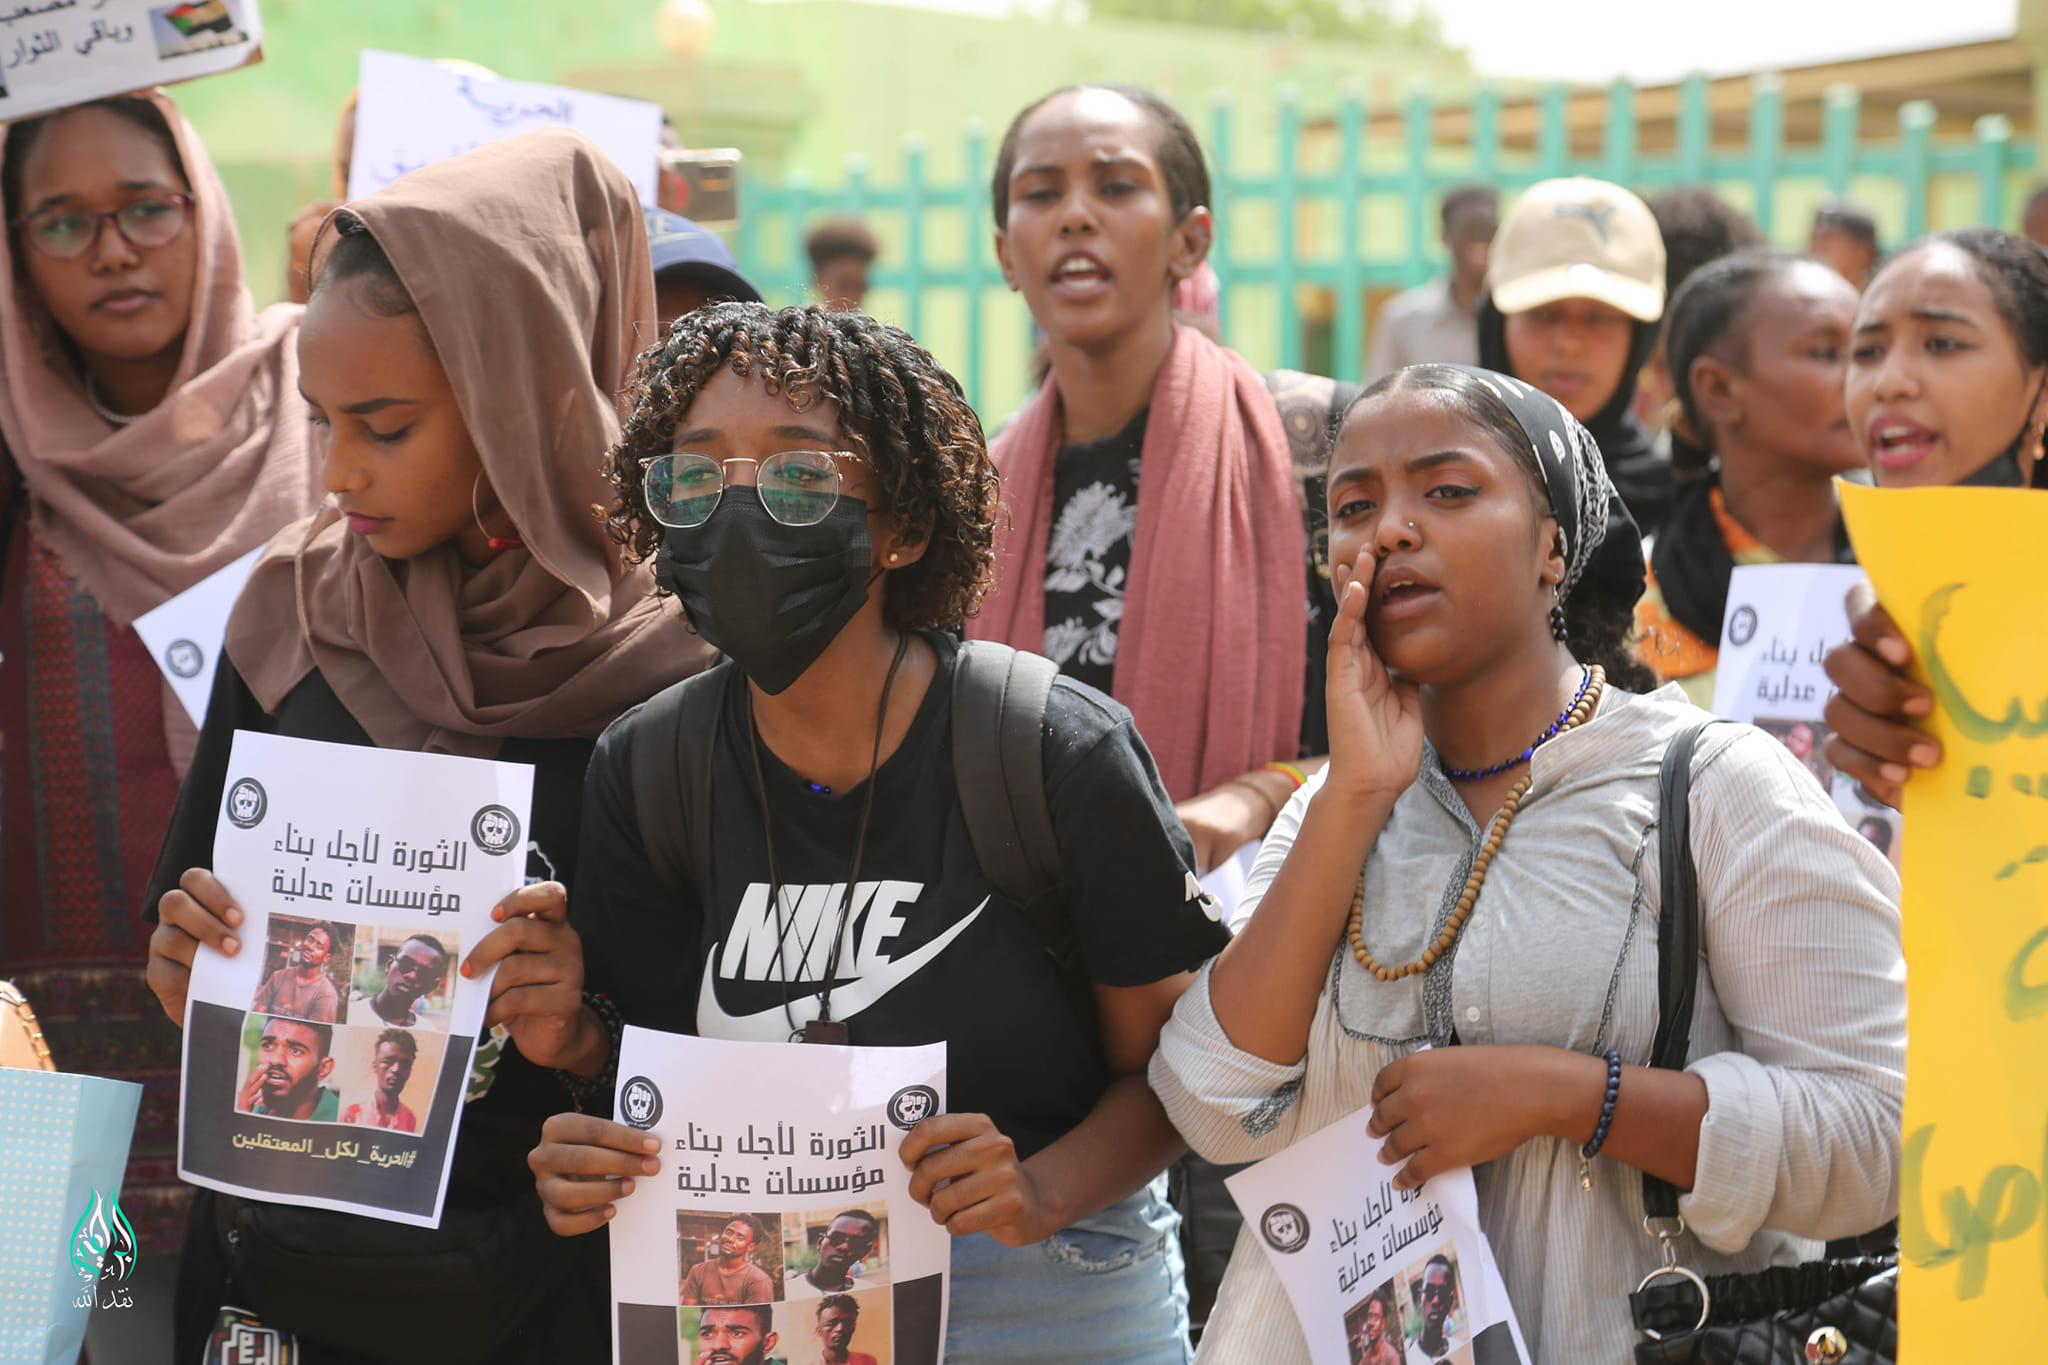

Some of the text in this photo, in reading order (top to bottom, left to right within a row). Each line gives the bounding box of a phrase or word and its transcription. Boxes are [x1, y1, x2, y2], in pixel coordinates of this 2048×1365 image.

[5, 30, 62, 69] الثوار
[1757, 672, 1815, 704] عدلية
[273, 822, 467, 874] الثورة لأجل بناء
[271, 867, 462, 917] مؤسسات عدلية
[719, 880, 925, 983] NIKE
[231, 1131, 418, 1169] #الحرية_لكل_المعتقلين
[675, 1120, 887, 1162] الثورة لأجل بناء
[677, 1162, 885, 1198] مؤسسات عدلية
[1330, 1217, 1359, 1254] بناء
[1337, 1202, 1445, 1295] مؤسسات عدلية
